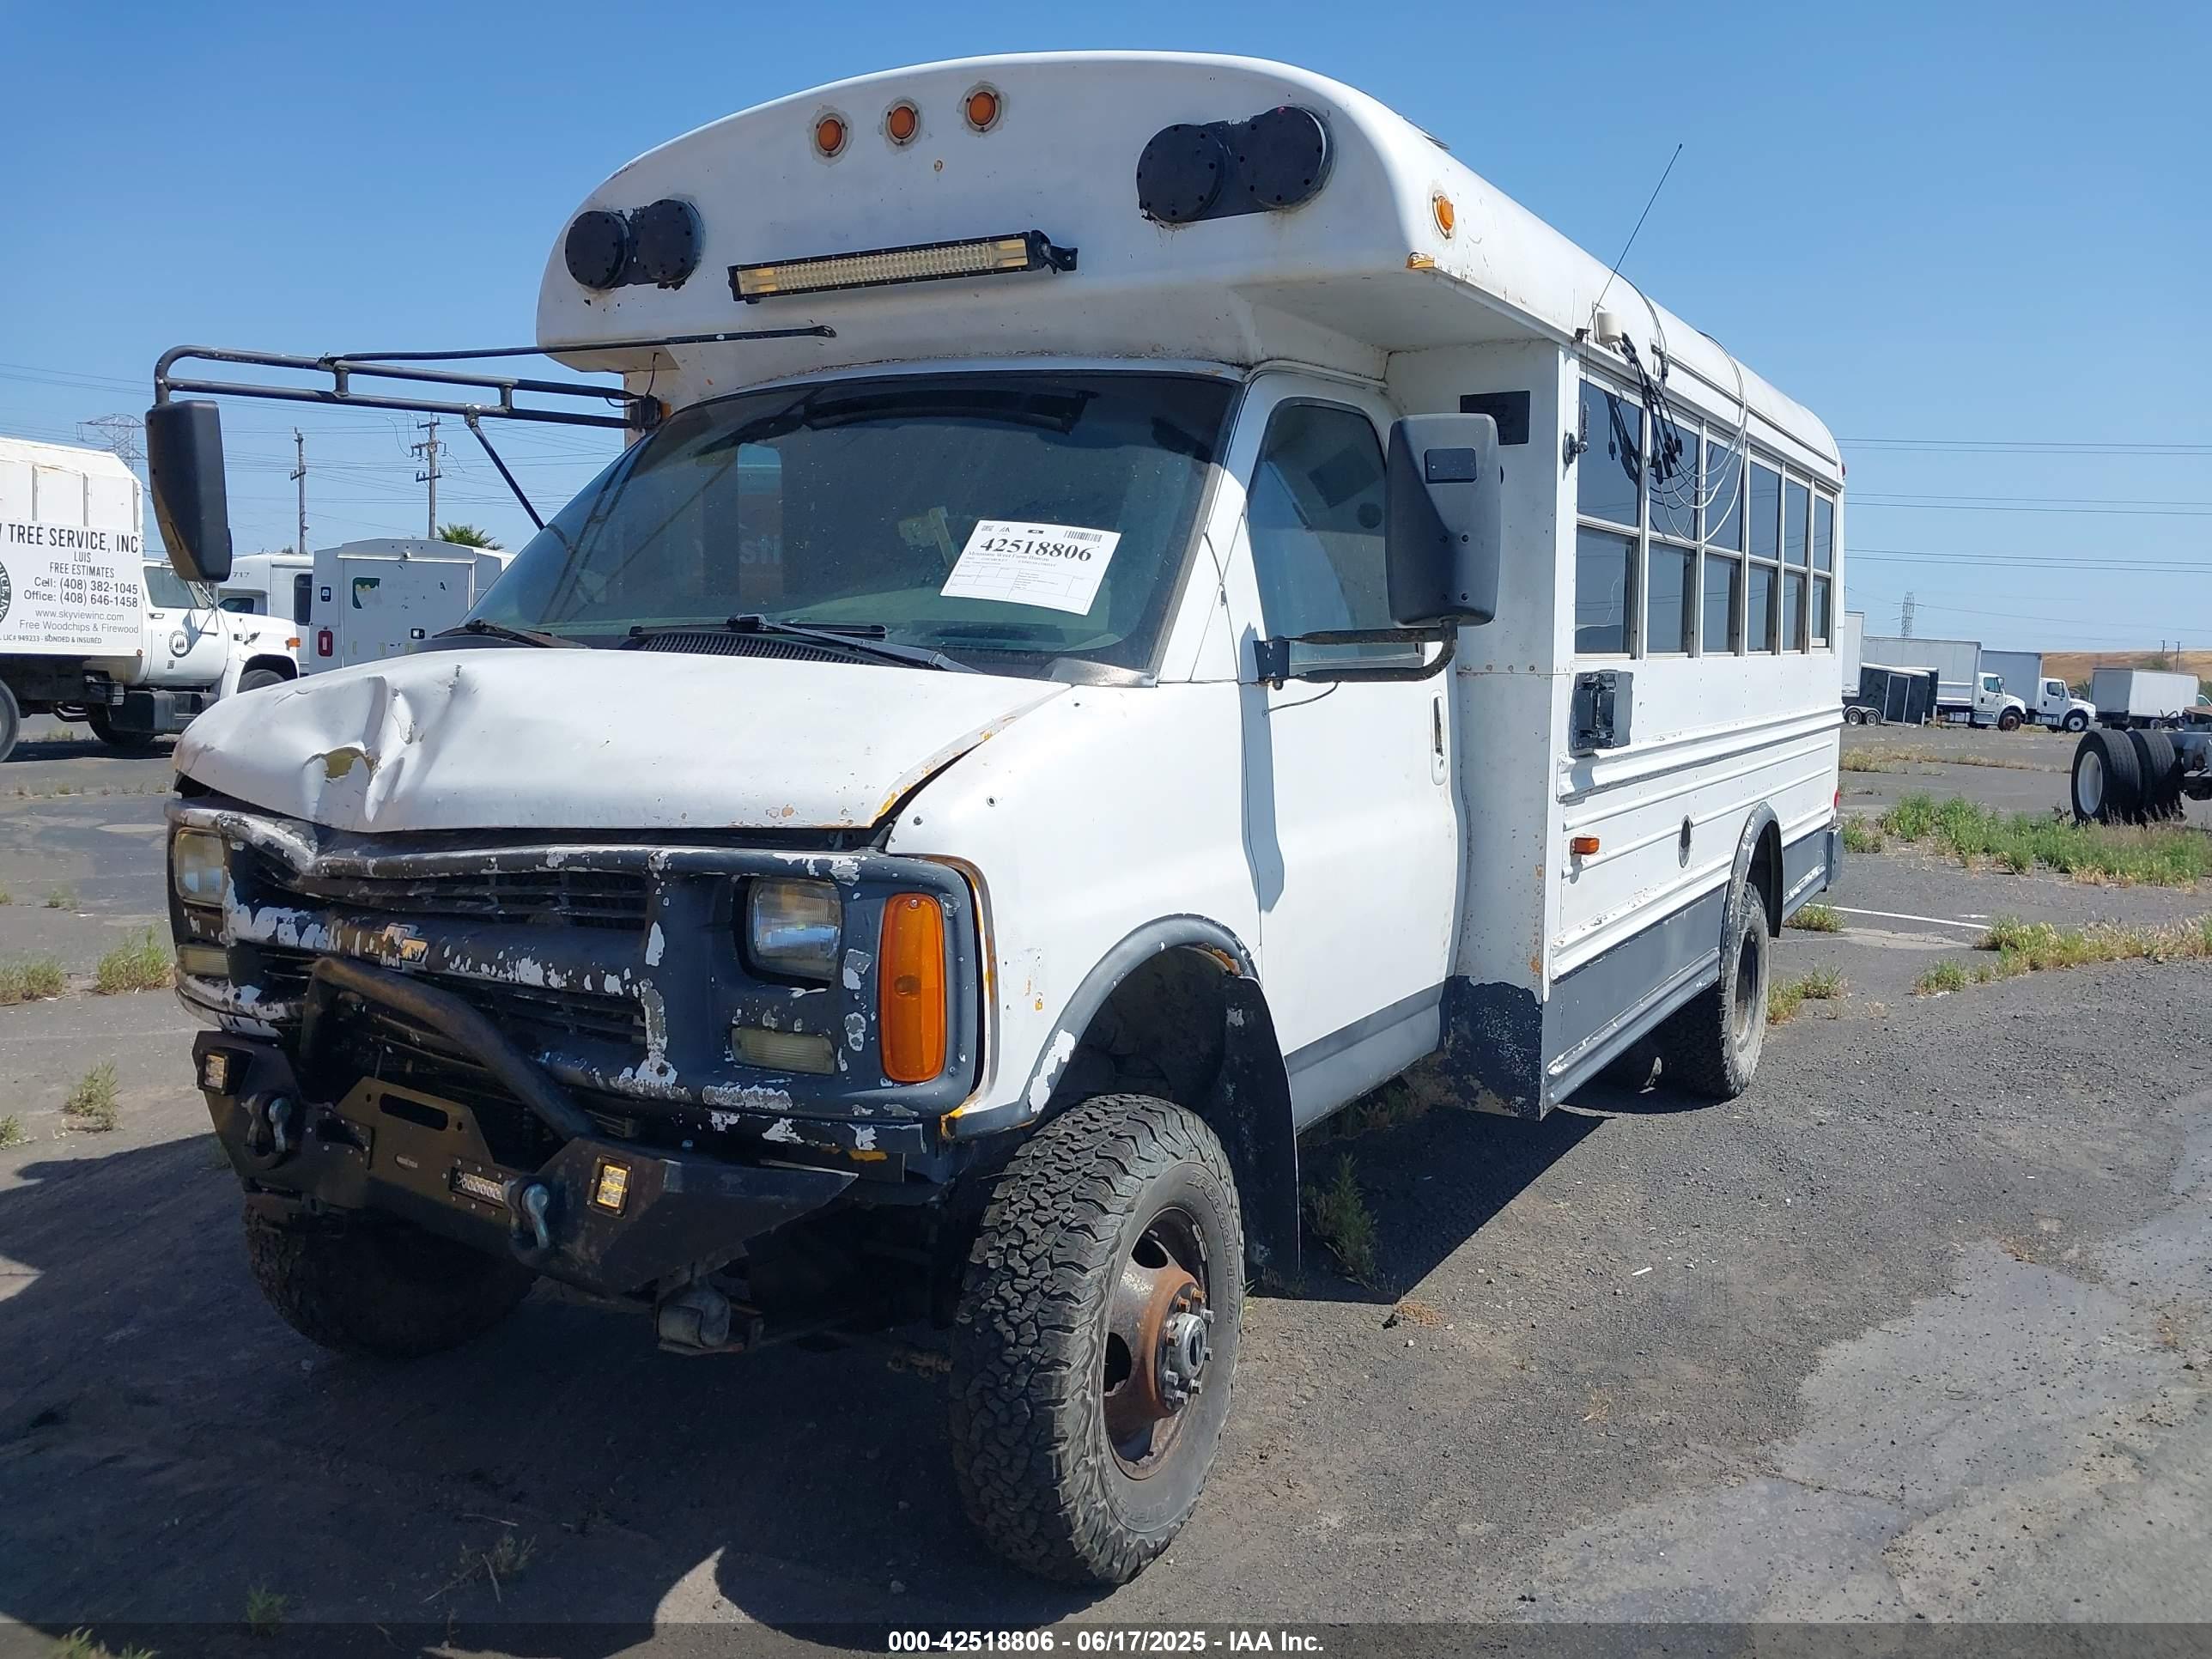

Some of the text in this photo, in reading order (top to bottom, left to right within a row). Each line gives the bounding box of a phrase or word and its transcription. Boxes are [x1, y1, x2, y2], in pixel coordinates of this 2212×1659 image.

[8, 524, 44, 545] TREE
[49, 528, 111, 553] SERVICE,
[116, 534, 138, 553] INC
[74, 551, 91, 562] LUIS
[980, 538, 1098, 562] 42518806
[50, 562, 114, 578] FREE ESTIMATES
[34, 577, 138, 594] Cell: (408) 382-1045
[24, 590, 138, 608] Office: (408) 646-1458
[35, 609, 125, 622] www.skyviewinc.com
[20, 620, 139, 634] Free Woodchips & Firewood
